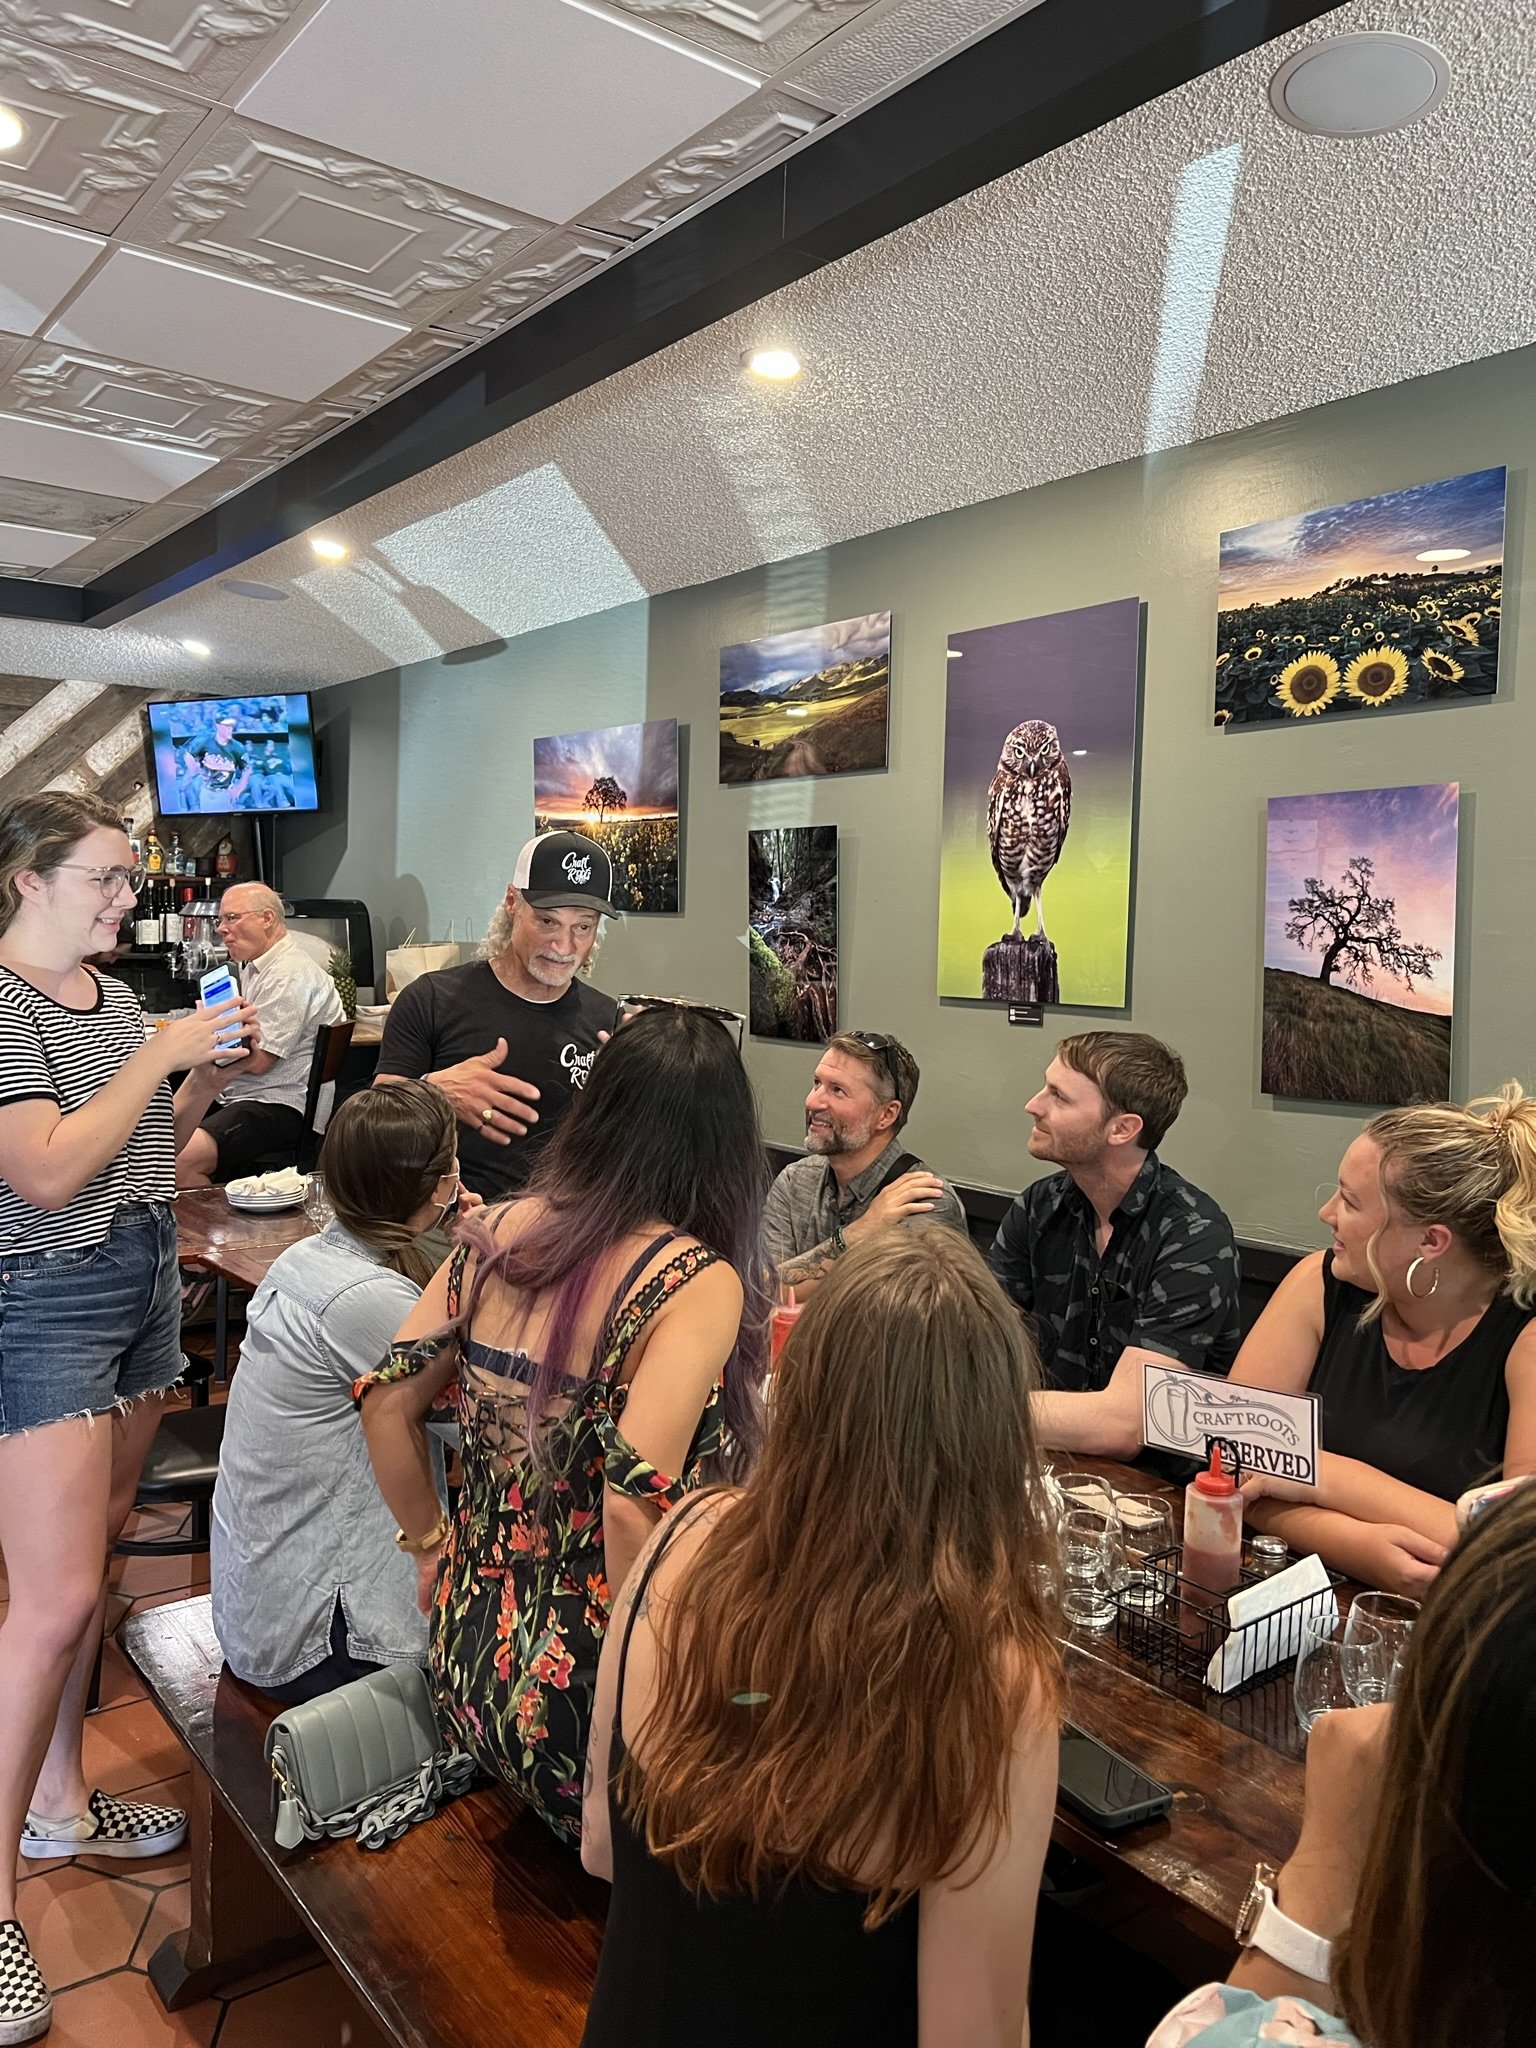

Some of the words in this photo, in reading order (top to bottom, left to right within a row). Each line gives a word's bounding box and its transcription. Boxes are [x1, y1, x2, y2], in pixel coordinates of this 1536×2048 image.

[562, 851, 590, 871] Craft
[567, 867, 592, 885] Roots
[560, 1043, 596, 1070] Craft
